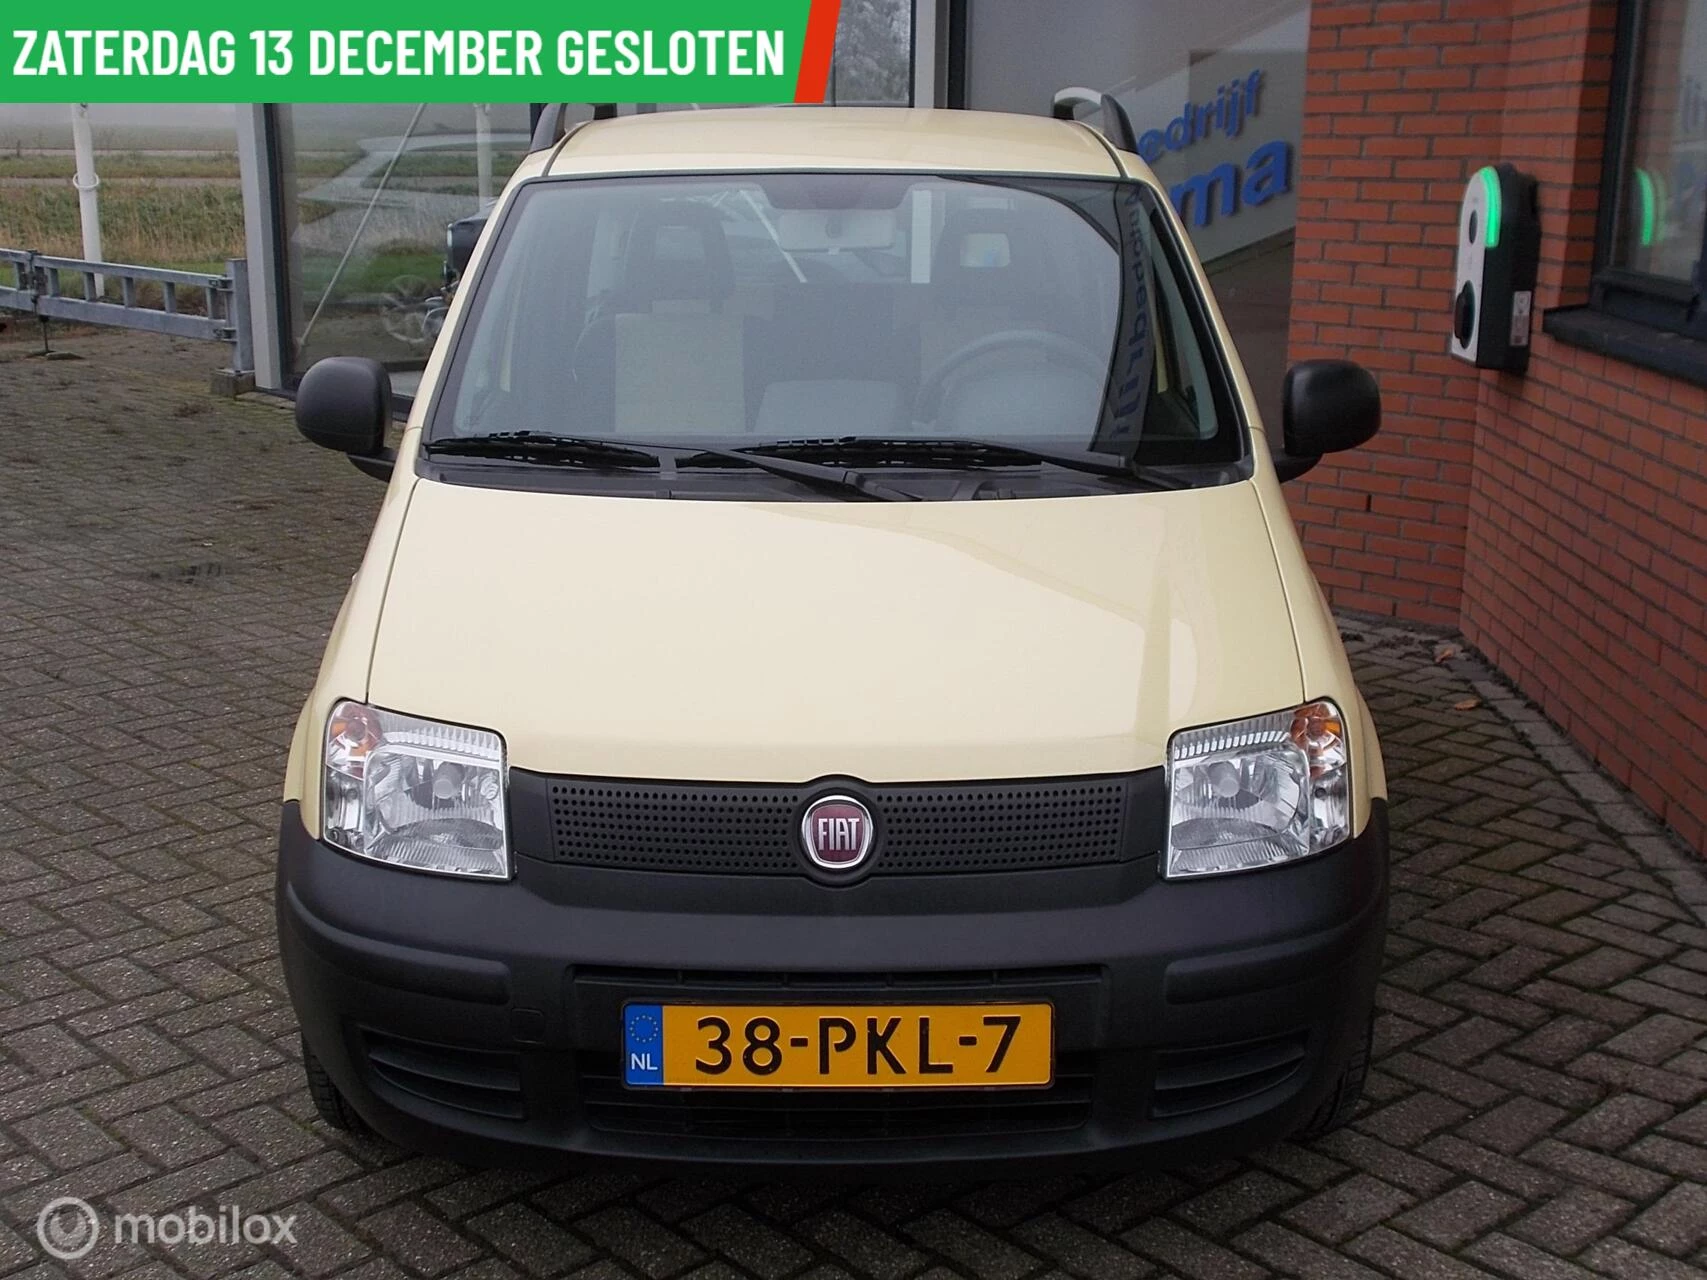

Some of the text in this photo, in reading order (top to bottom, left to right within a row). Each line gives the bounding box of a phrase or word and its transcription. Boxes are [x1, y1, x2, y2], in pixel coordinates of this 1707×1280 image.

[818, 818, 860, 850] FIAT
[630, 1016, 1022, 1075] NL 38-PKL-7
